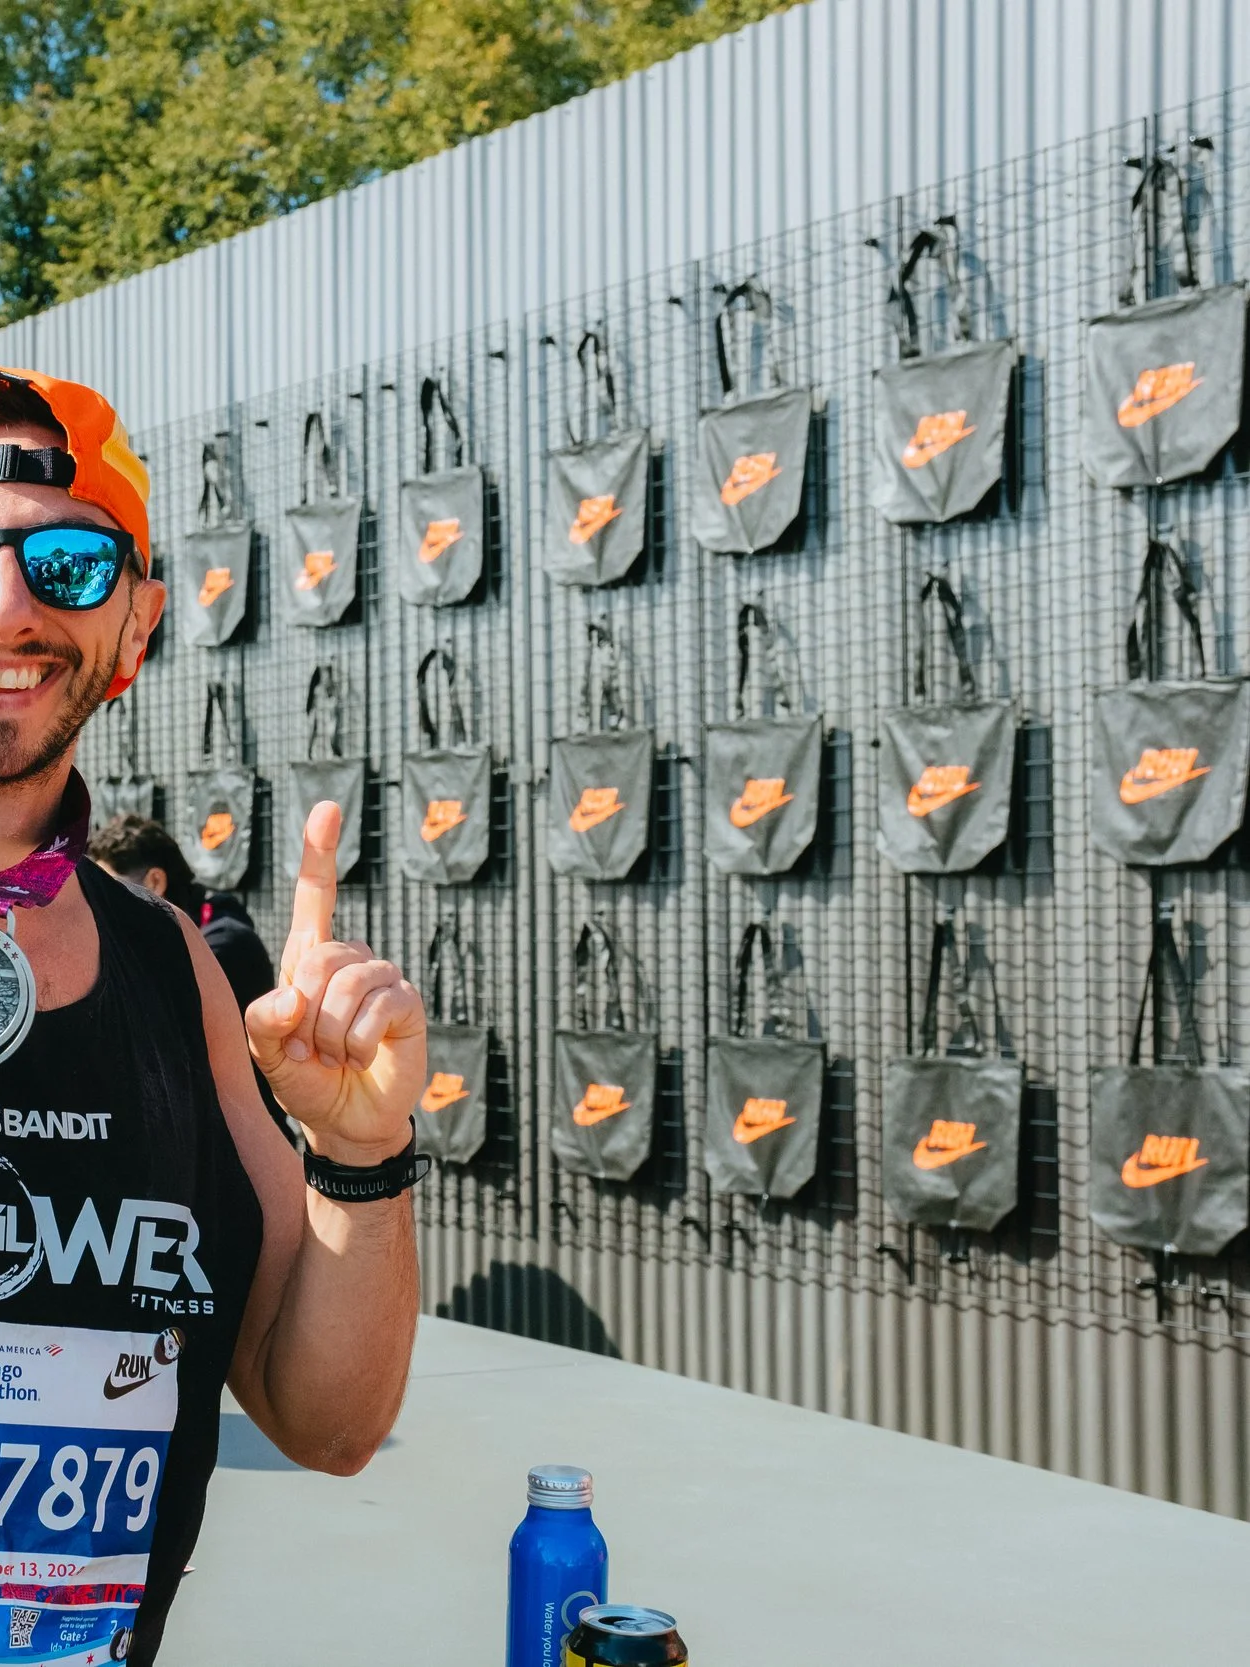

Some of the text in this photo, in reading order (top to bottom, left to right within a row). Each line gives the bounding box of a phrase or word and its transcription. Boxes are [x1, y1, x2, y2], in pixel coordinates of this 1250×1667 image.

[4, 1110, 111, 1140] BANDIT
[1140, 1134, 1199, 1168] RUN
[131, 1293, 214, 1315] FITNESS
[0, 1345, 41, 1356] AMERICA
[115, 1353, 152, 1380] RUN
[20, 1562, 42, 1579] 13,
[544, 1602, 555, 1635] Water
[60, 1630, 81, 1642] Gate
[542, 1637, 552, 1656] you
